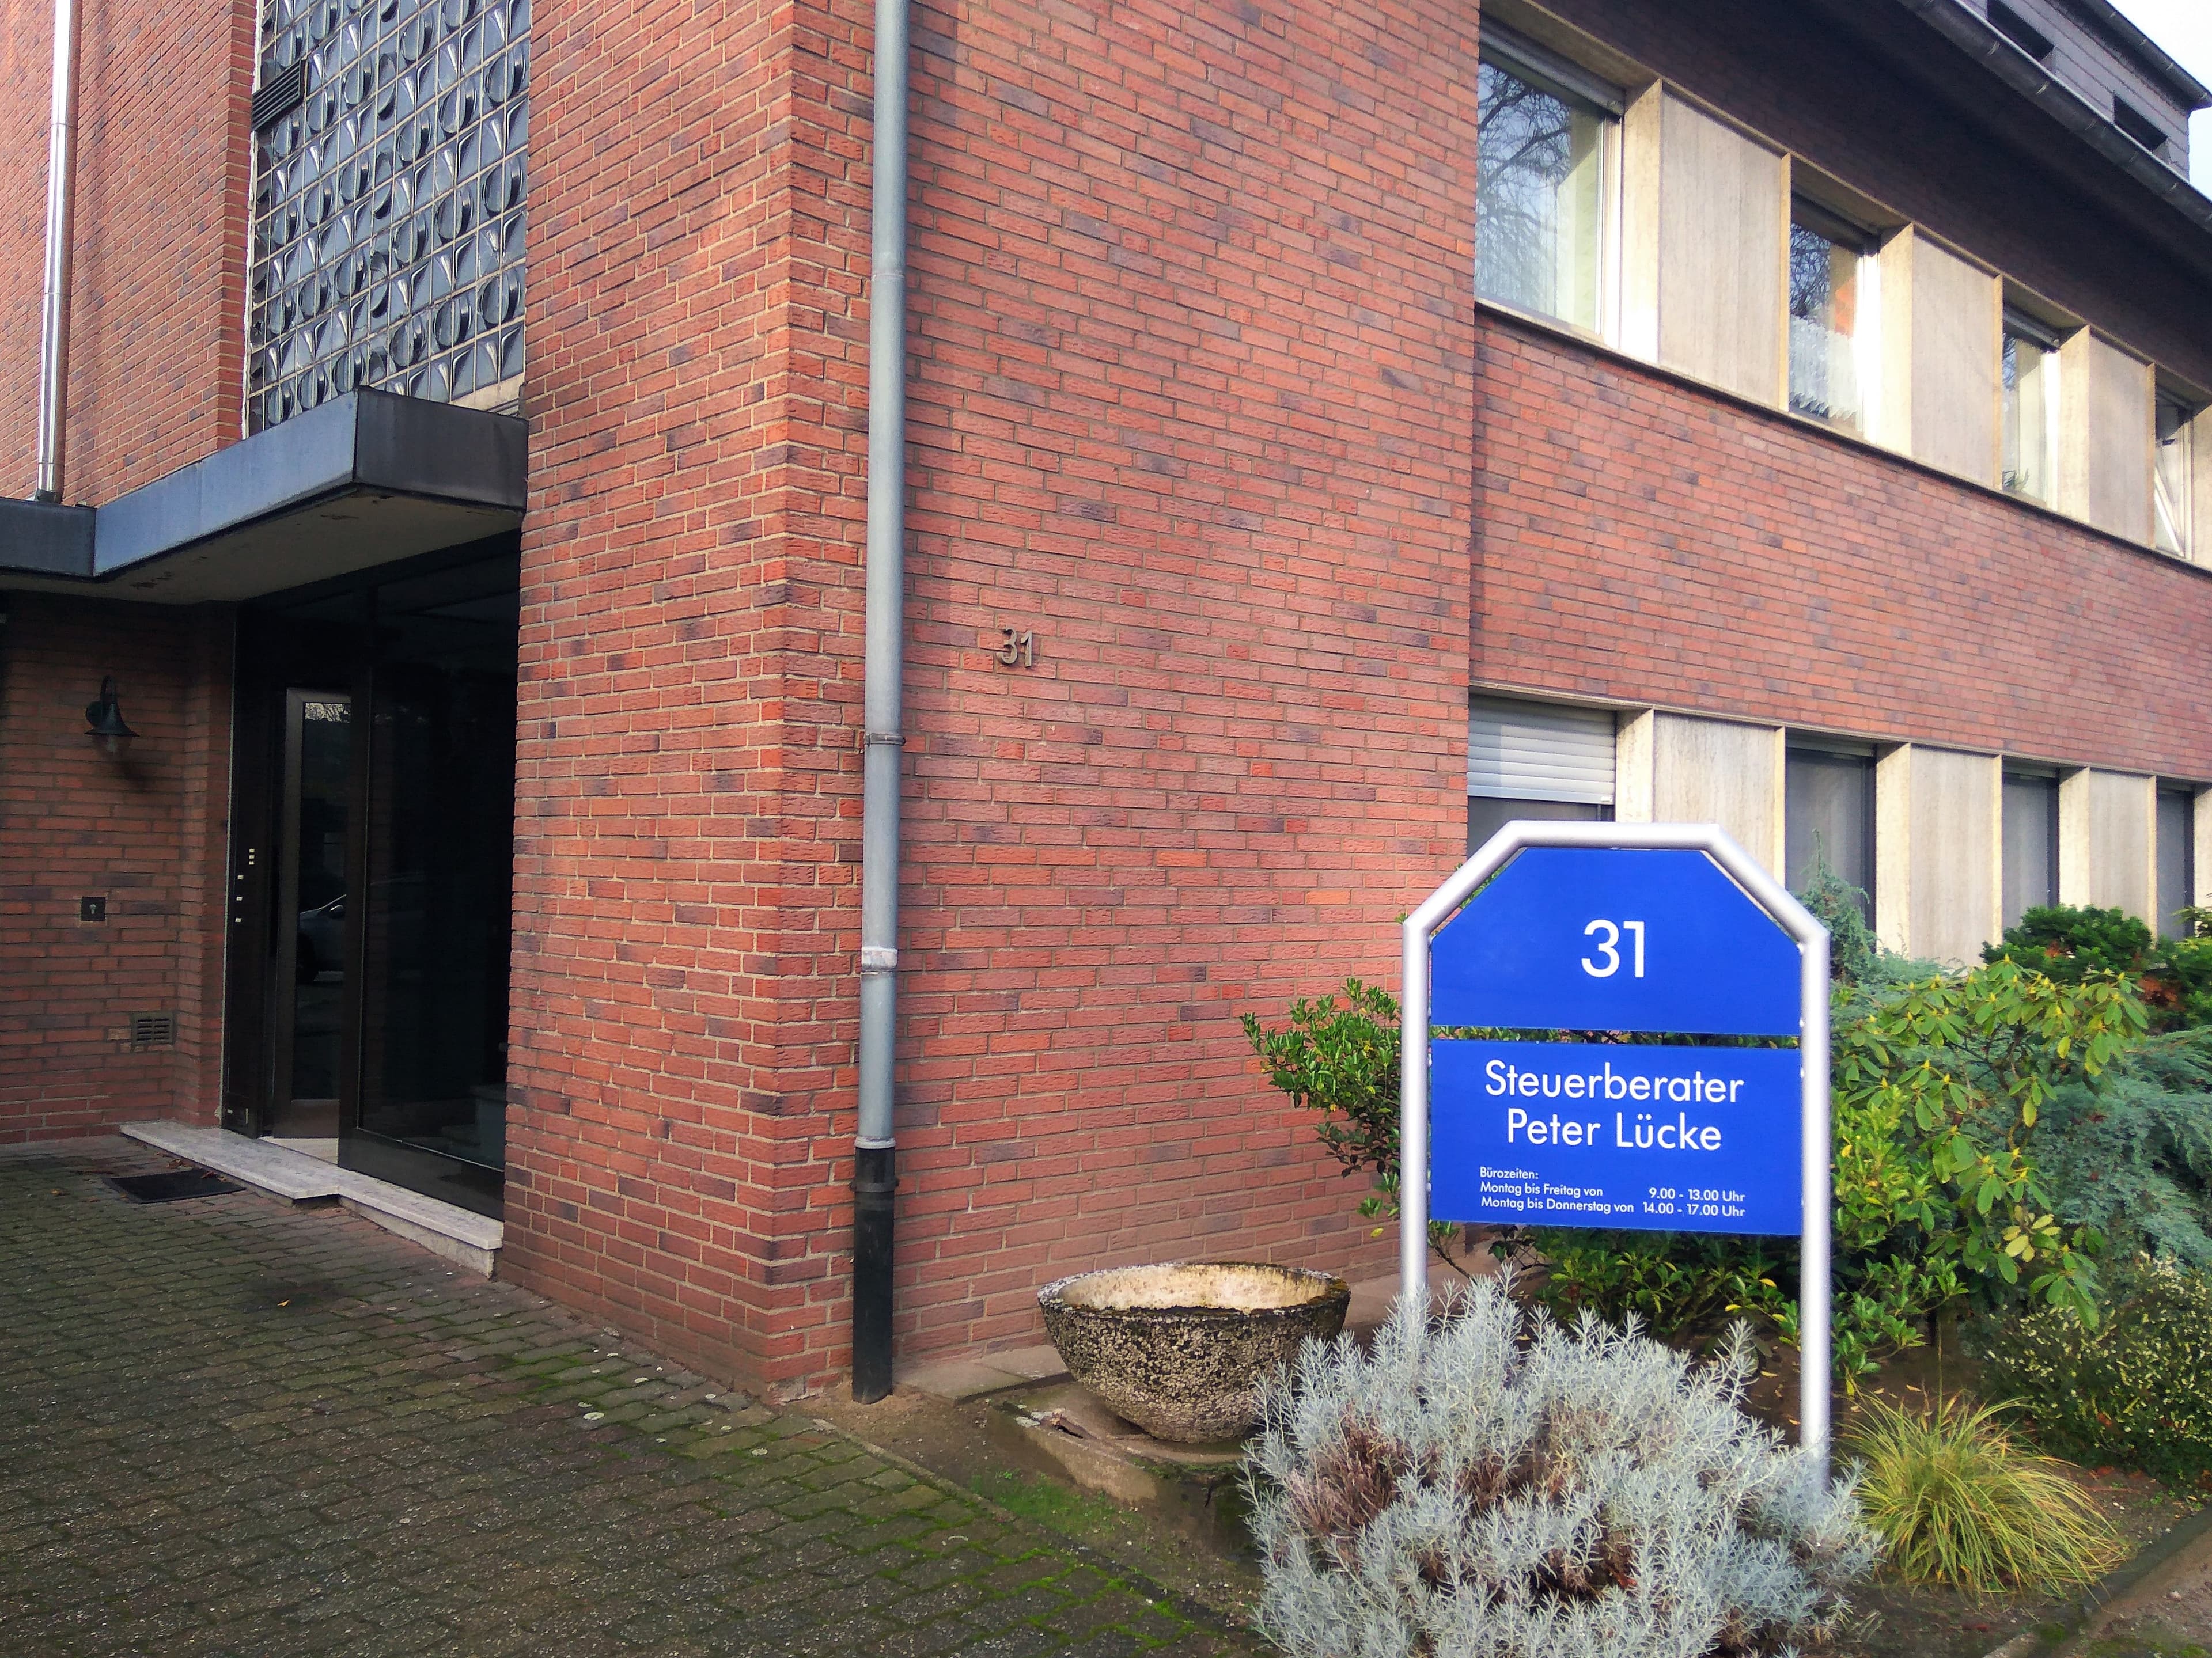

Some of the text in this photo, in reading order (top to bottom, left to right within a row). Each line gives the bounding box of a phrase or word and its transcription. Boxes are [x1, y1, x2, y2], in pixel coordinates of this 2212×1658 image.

[996, 627, 1032, 668] 31
[1581, 919, 1645, 978] 31
[1484, 1059, 1745, 1103] Steuerberater
[1508, 1107, 1722, 1151] Peter Lücke
[1479, 1166, 1539, 1180] Bürozeiten:
[1480, 1181, 1522, 1197] Montag
[1525, 1182, 1540, 1194] bis
[1543, 1183, 1581, 1198] Freitag
[1583, 1188, 1603, 1197] von
[1649, 1187, 1676, 1200] 9.00
[1687, 1189, 1719, 1201] 13.00
[1722, 1190, 1745, 1202] Uhr
[1481, 1196, 1524, 1211] Montag
[1527, 1197, 1543, 1209] bis
[1546, 1198, 1611, 1215] Donnerstag
[1613, 1204, 1634, 1213] von
[1642, 1201, 1674, 1215] 14.00
[1686, 1204, 1719, 1216] 17.00
[1722, 1205, 1745, 1217] Uhr
